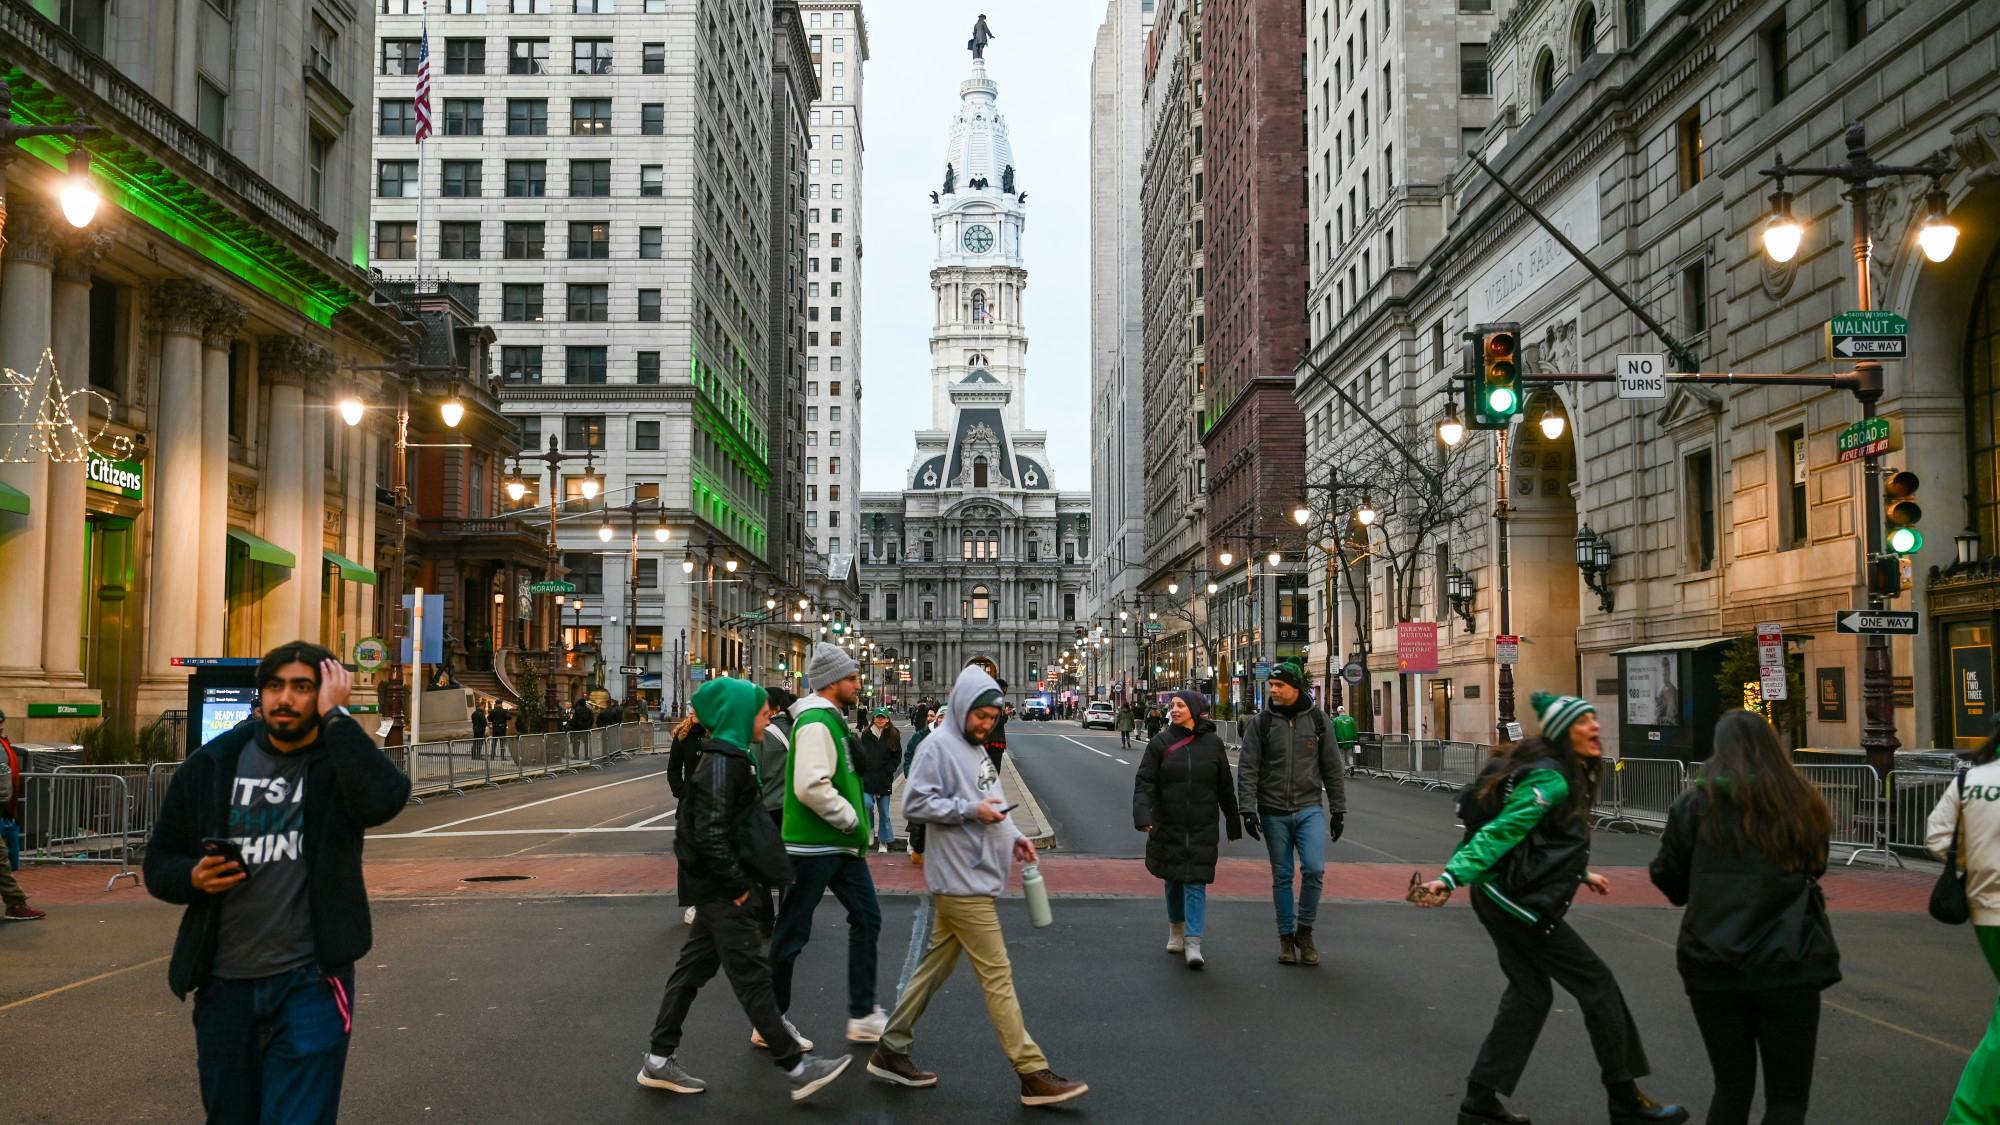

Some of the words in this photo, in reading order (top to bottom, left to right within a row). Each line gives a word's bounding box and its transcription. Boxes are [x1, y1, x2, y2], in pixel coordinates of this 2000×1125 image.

[1484, 261, 1523, 312] WELLS
[1834, 320, 1889, 334] WALNUT
[1894, 324, 1905, 334] ST
[1854, 342, 1875, 352] ONE
[1877, 342, 1899, 351] WAY
[1628, 360, 1653, 375] NO
[1620, 379, 1662, 391] TURNS
[1847, 427, 1878, 448] BROAD
[1880, 427, 1888, 439] ST
[90, 459, 141, 491] Citizens
[531, 584, 565, 592] MORAVIAN
[1861, 618, 1882, 627] ONE
[1887, 618, 1910, 627] WAY
[1967, 672, 1977, 680] ONE
[1967, 681, 1979, 690] TWO
[1968, 690, 1983, 699] THREE
[214, 711, 234, 721] READY
[230, 830, 304, 865] HIN
